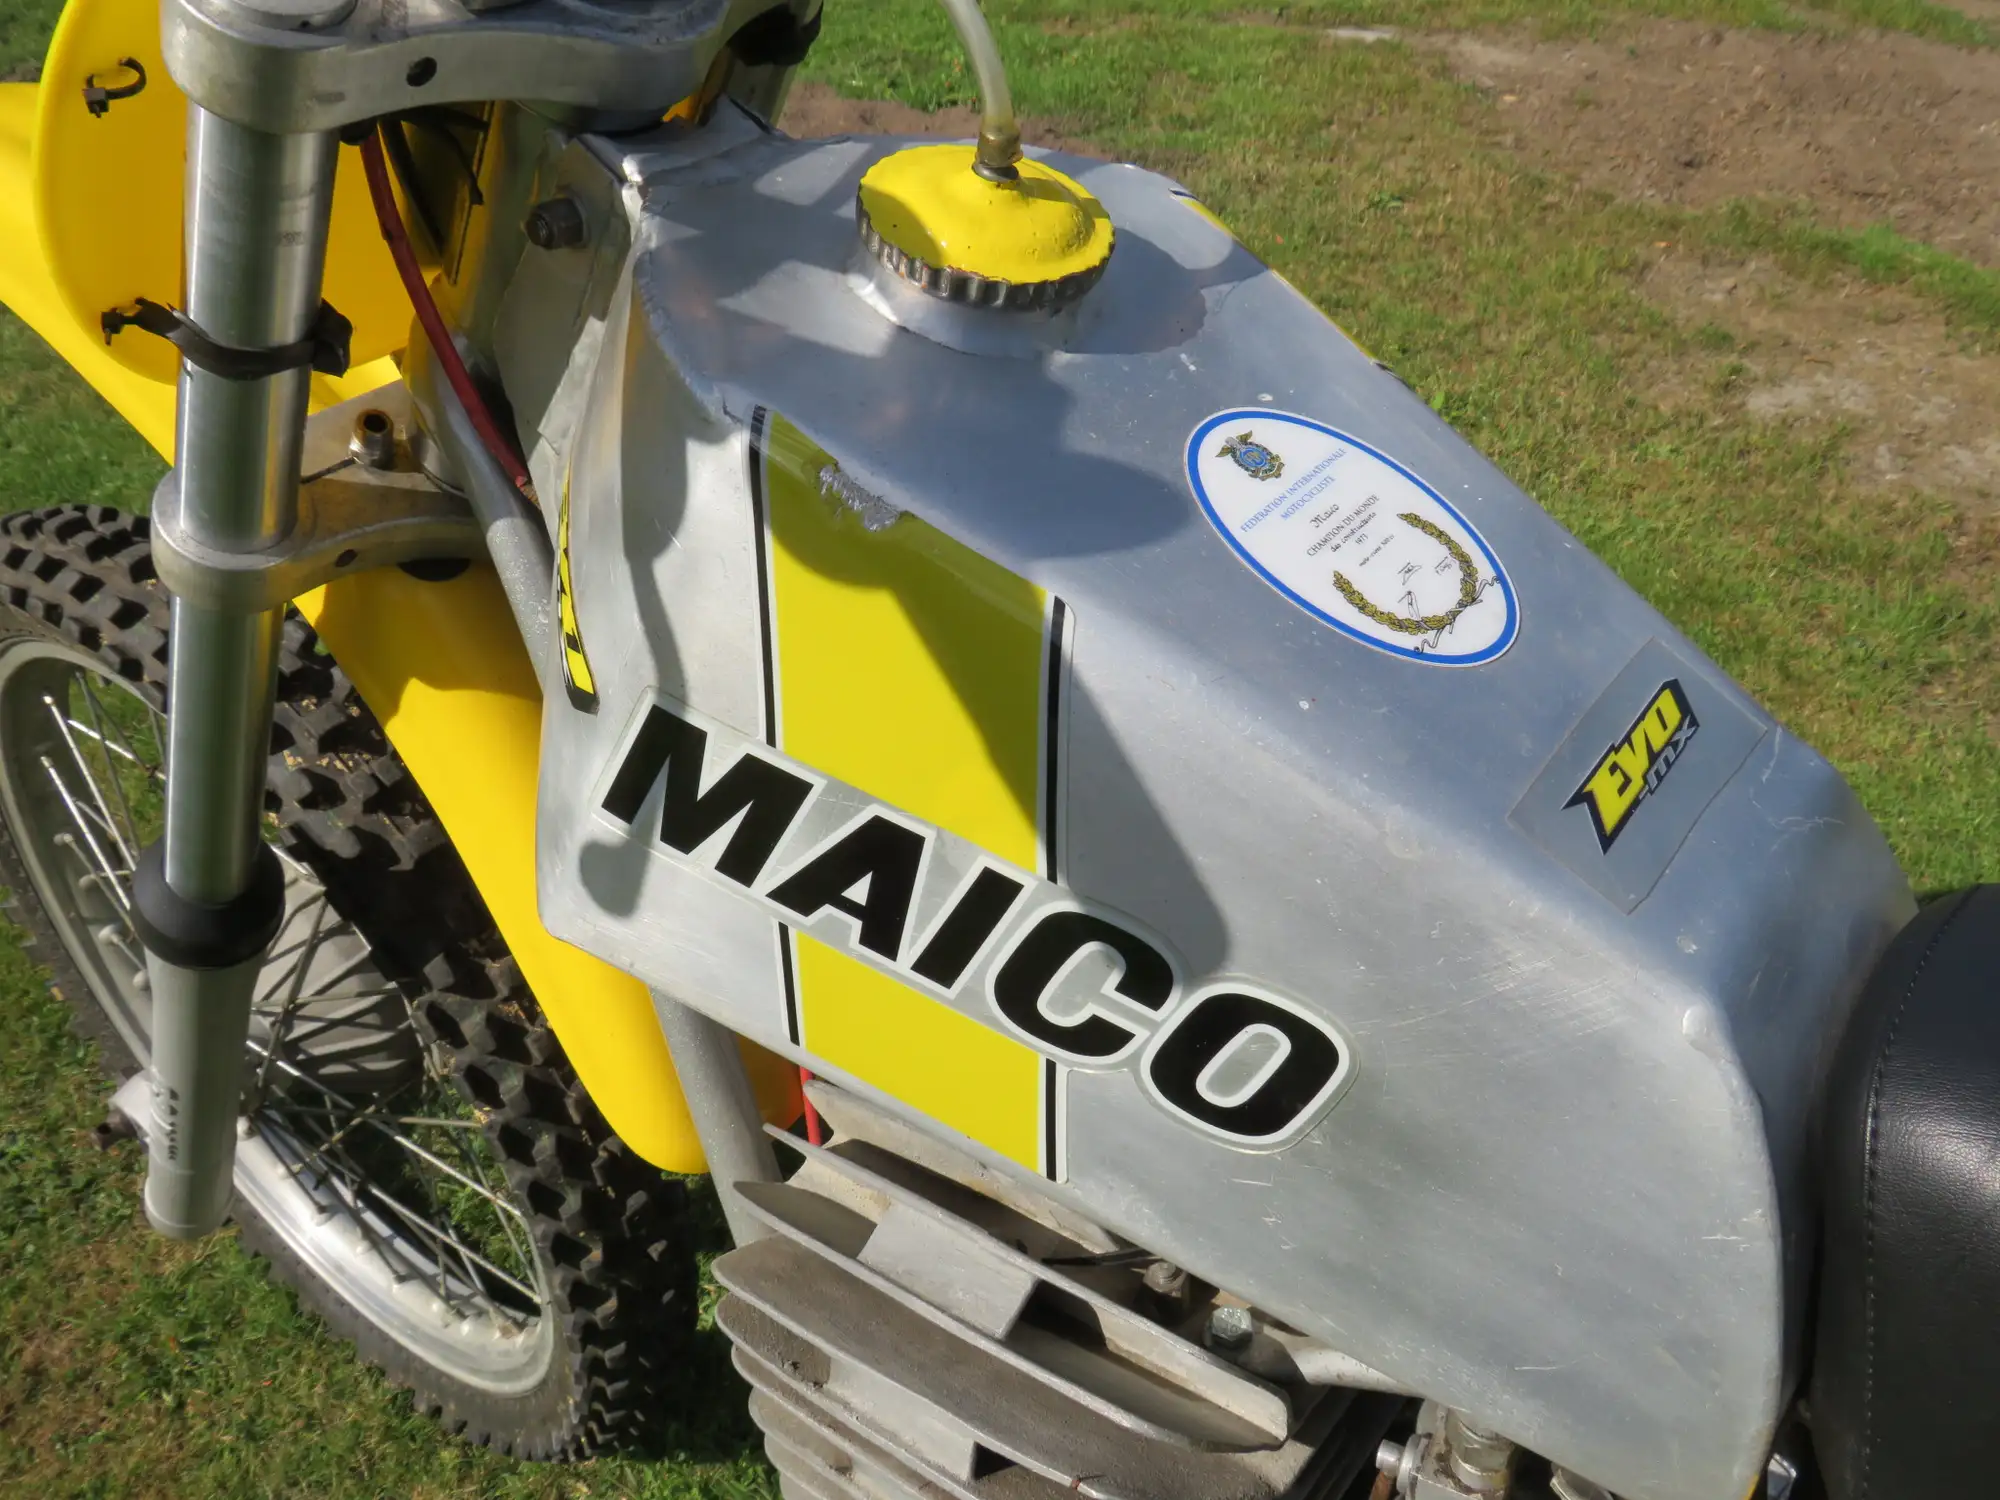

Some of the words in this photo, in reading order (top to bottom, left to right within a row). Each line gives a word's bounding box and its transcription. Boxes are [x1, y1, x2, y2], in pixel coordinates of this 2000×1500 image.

[1240, 492, 1289, 532] FEDERATION
[1286, 447, 1347, 495] INTERNATIONALE
[1280, 475, 1336, 520] MOTOCYCLISTE
[1309, 503, 1340, 528] Maico
[1306, 521, 1345, 557] CHAMPION
[1342, 510, 1358, 527] DU
[1354, 493, 1380, 516] MONDE
[602, 703, 1343, 1137] MAICO
